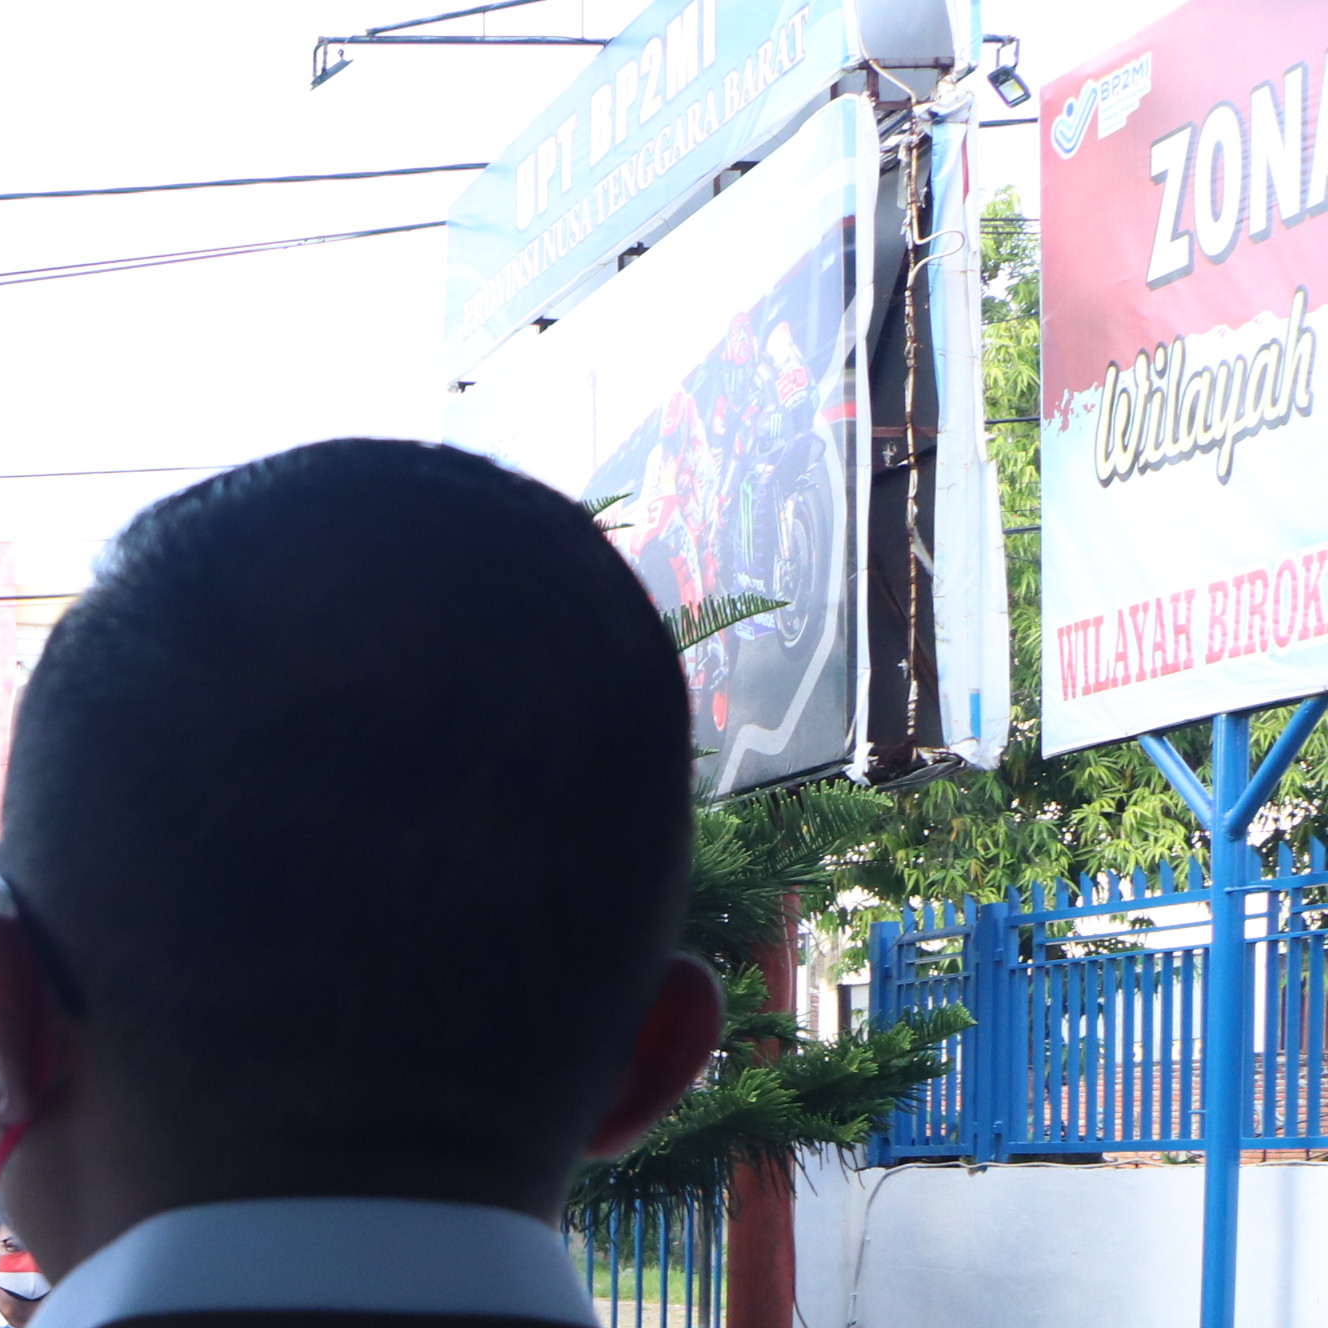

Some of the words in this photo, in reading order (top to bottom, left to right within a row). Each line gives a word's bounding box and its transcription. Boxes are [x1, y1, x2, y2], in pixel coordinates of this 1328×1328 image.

[462, 237, 541, 340] PROVINSI
[541, 202, 594, 267] NUSA
[593, 89, 721, 225] TENGGARA
[723, 8, 810, 120] BARAT
[515, 114, 577, 231] UPT
[591, 0, 718, 165] BP2MI
[1100, 56, 1149, 102] BP2MI
[1095, 285, 1316, 486] Wilayah
[1056, 588, 1196, 702] WILAYAH
[1205, 549, 1328, 664] BIROK
